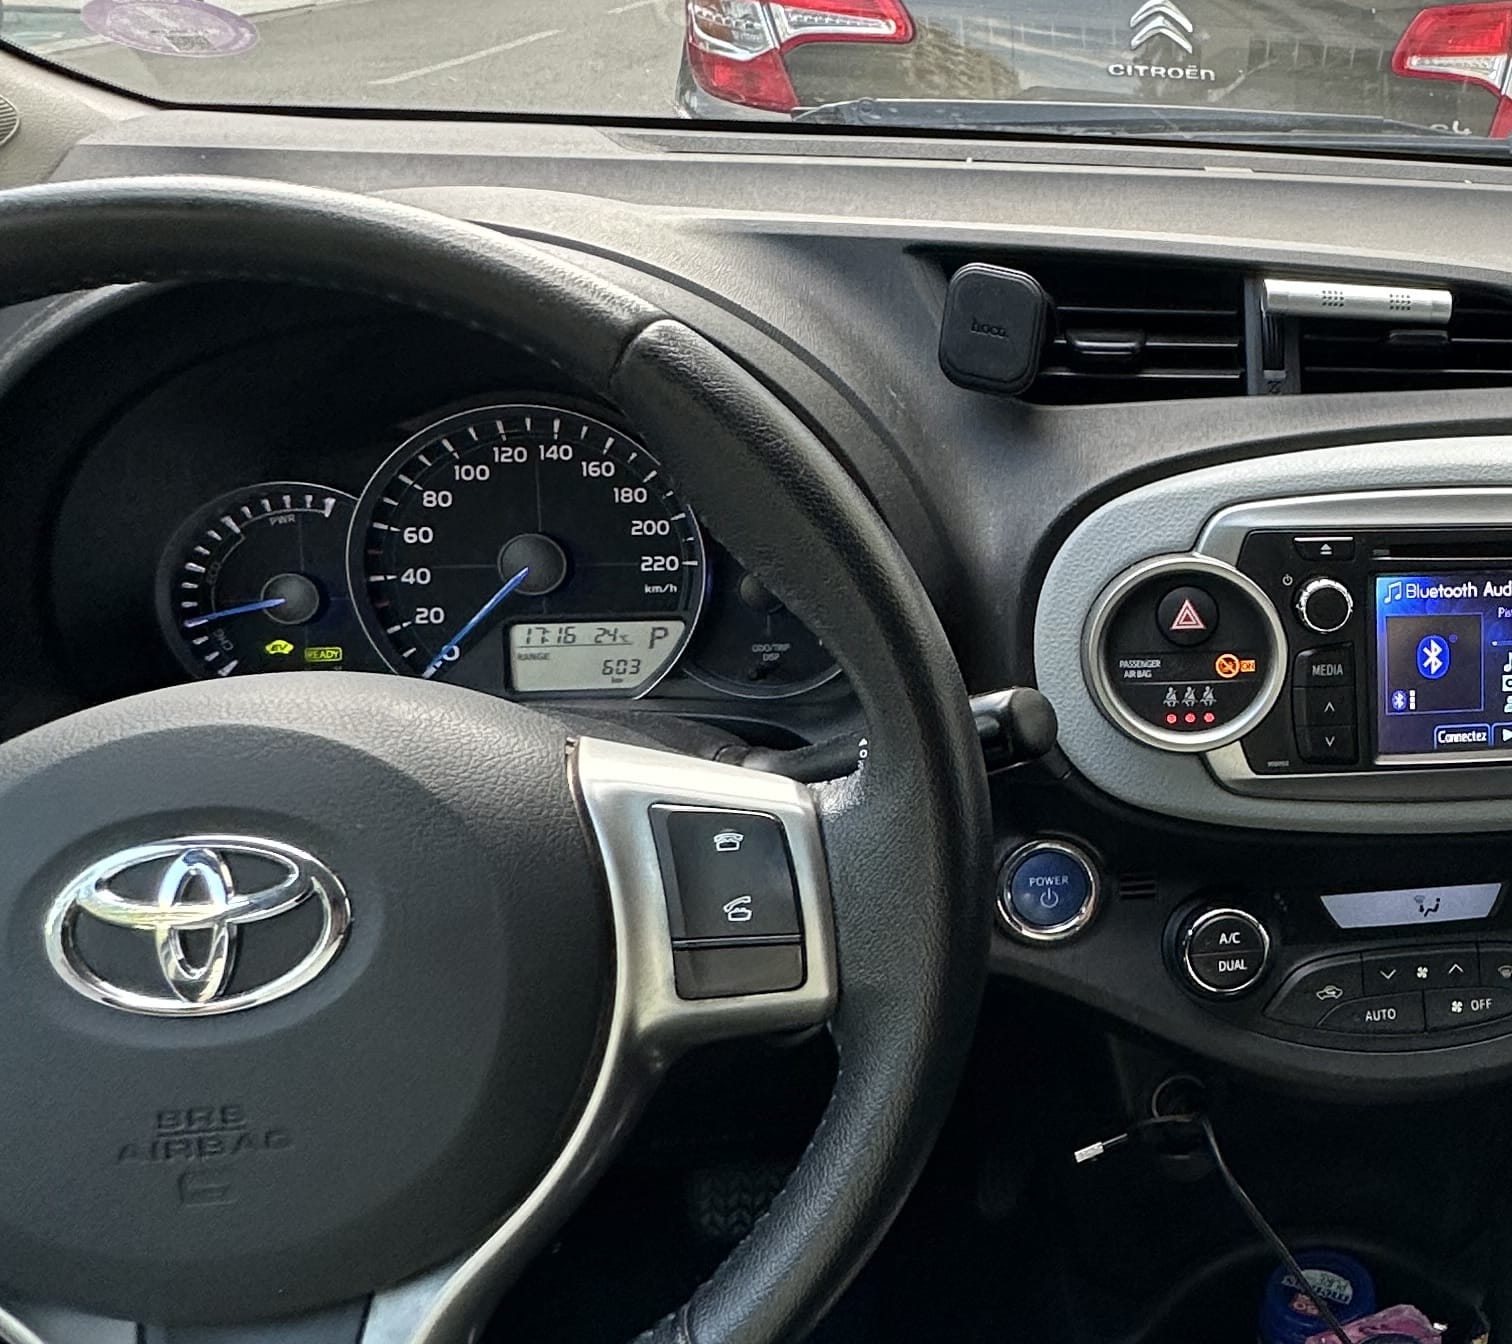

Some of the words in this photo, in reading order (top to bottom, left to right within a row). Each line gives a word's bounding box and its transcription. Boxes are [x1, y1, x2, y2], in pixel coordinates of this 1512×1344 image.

[493, 447, 528, 463] 120
[539, 445, 573, 461] 140
[454, 465, 490, 481] 100
[581, 461, 616, 478] 160
[422, 491, 453, 507] 80
[613, 487, 648, 504] 180
[269, 514, 296, 526] PWR
[631, 520, 670, 536] 200
[403, 527, 434, 543] 60
[640, 556, 679, 572] 220
[401, 568, 432, 585] 40
[644, 583, 678, 594] km/h
[1405, 583, 1478, 600] Bluetooth
[415, 608, 446, 624] 20
[647, 626, 669, 650] P
[306, 650, 341, 659] READY
[441, 644, 461, 662] 0
[601, 659, 642, 676] 603
[1119, 659, 1161, 669] PASSENGER
[1312, 663, 1344, 677] MEDIA
[1437, 729, 1488, 745] Connectez
[1029, 875, 1069, 887] POWER
[1219, 931, 1241, 945] A/C
[1218, 958, 1248, 973] DUAL
[1470, 998, 1493, 1012] OFF
[1365, 1008, 1397, 1023] AUTO
